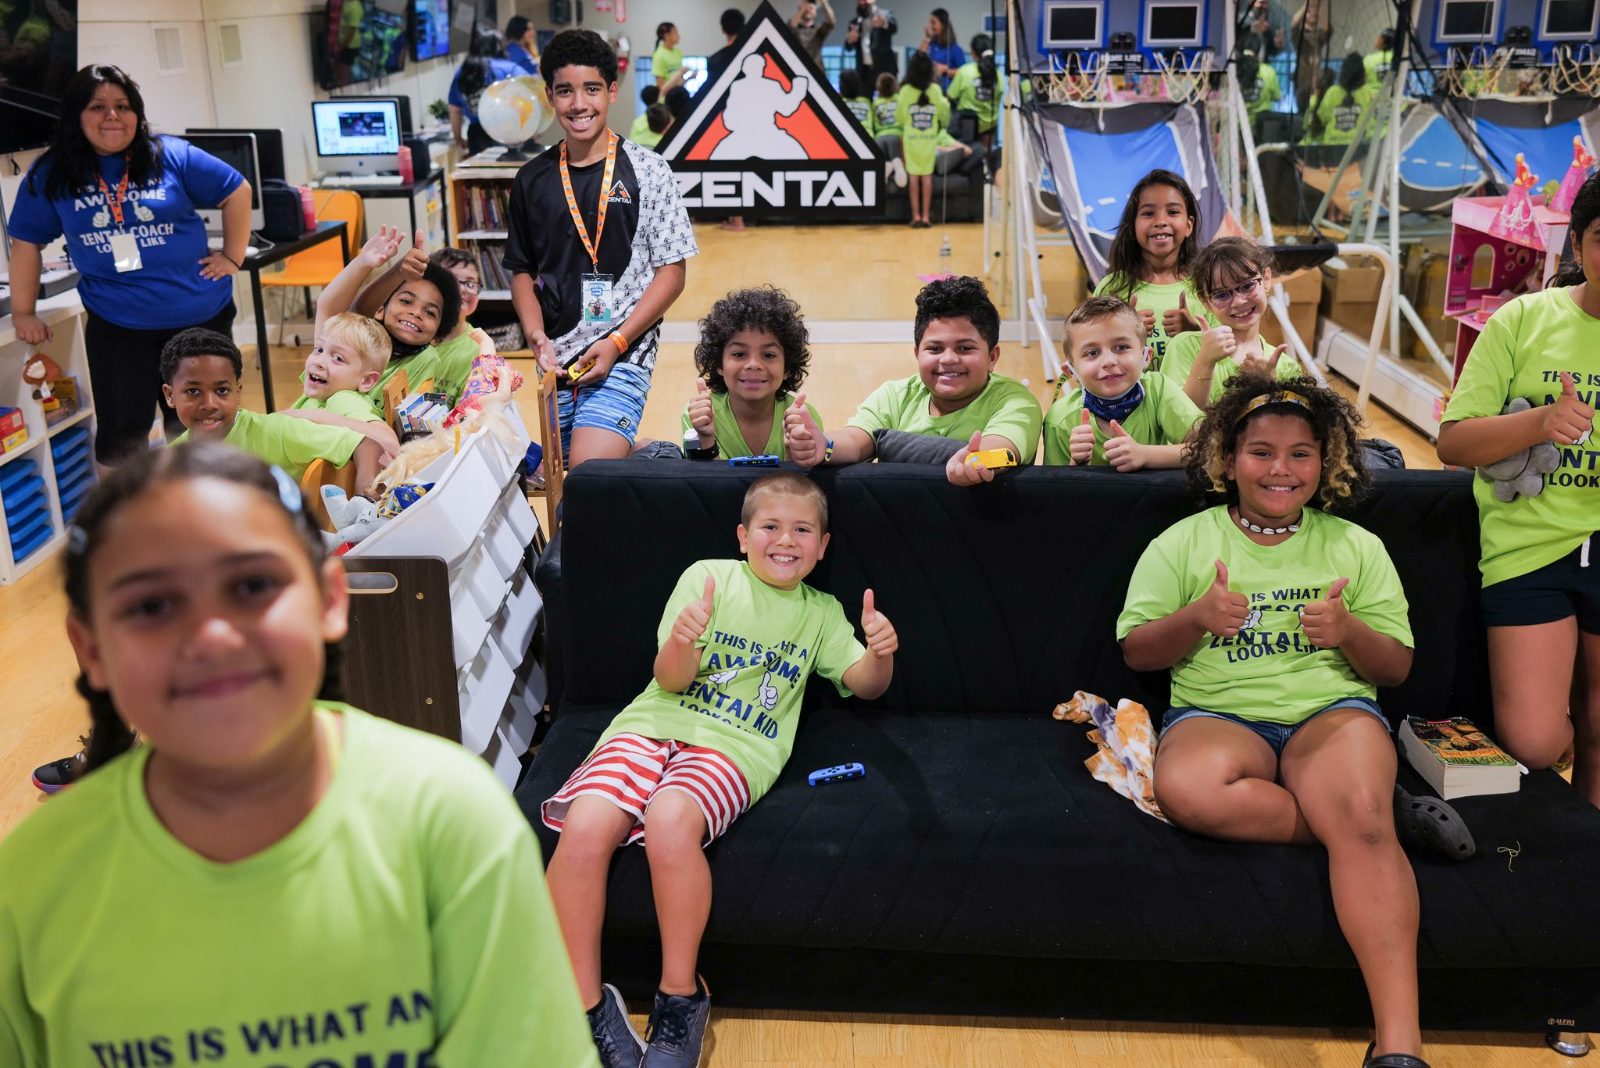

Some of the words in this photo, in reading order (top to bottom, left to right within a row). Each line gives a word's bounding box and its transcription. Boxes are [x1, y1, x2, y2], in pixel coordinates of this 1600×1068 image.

[674, 171, 876, 207] ZENTAI
[131, 223, 174, 238] COACH
[140, 236, 166, 248] LIKE
[1542, 371, 1582, 384] THS
[1251, 592, 1266, 602] IS
[1272, 588, 1321, 601] WHAT
[714, 630, 748, 650] THIS
[749, 641, 763, 655] IS
[707, 650, 802, 690] AWESOM
[752, 711, 779, 740] KID
[89, 1036, 177, 1068] THIS
[186, 1028, 227, 1063] IS
[238, 1003, 370, 1055] WHAT
